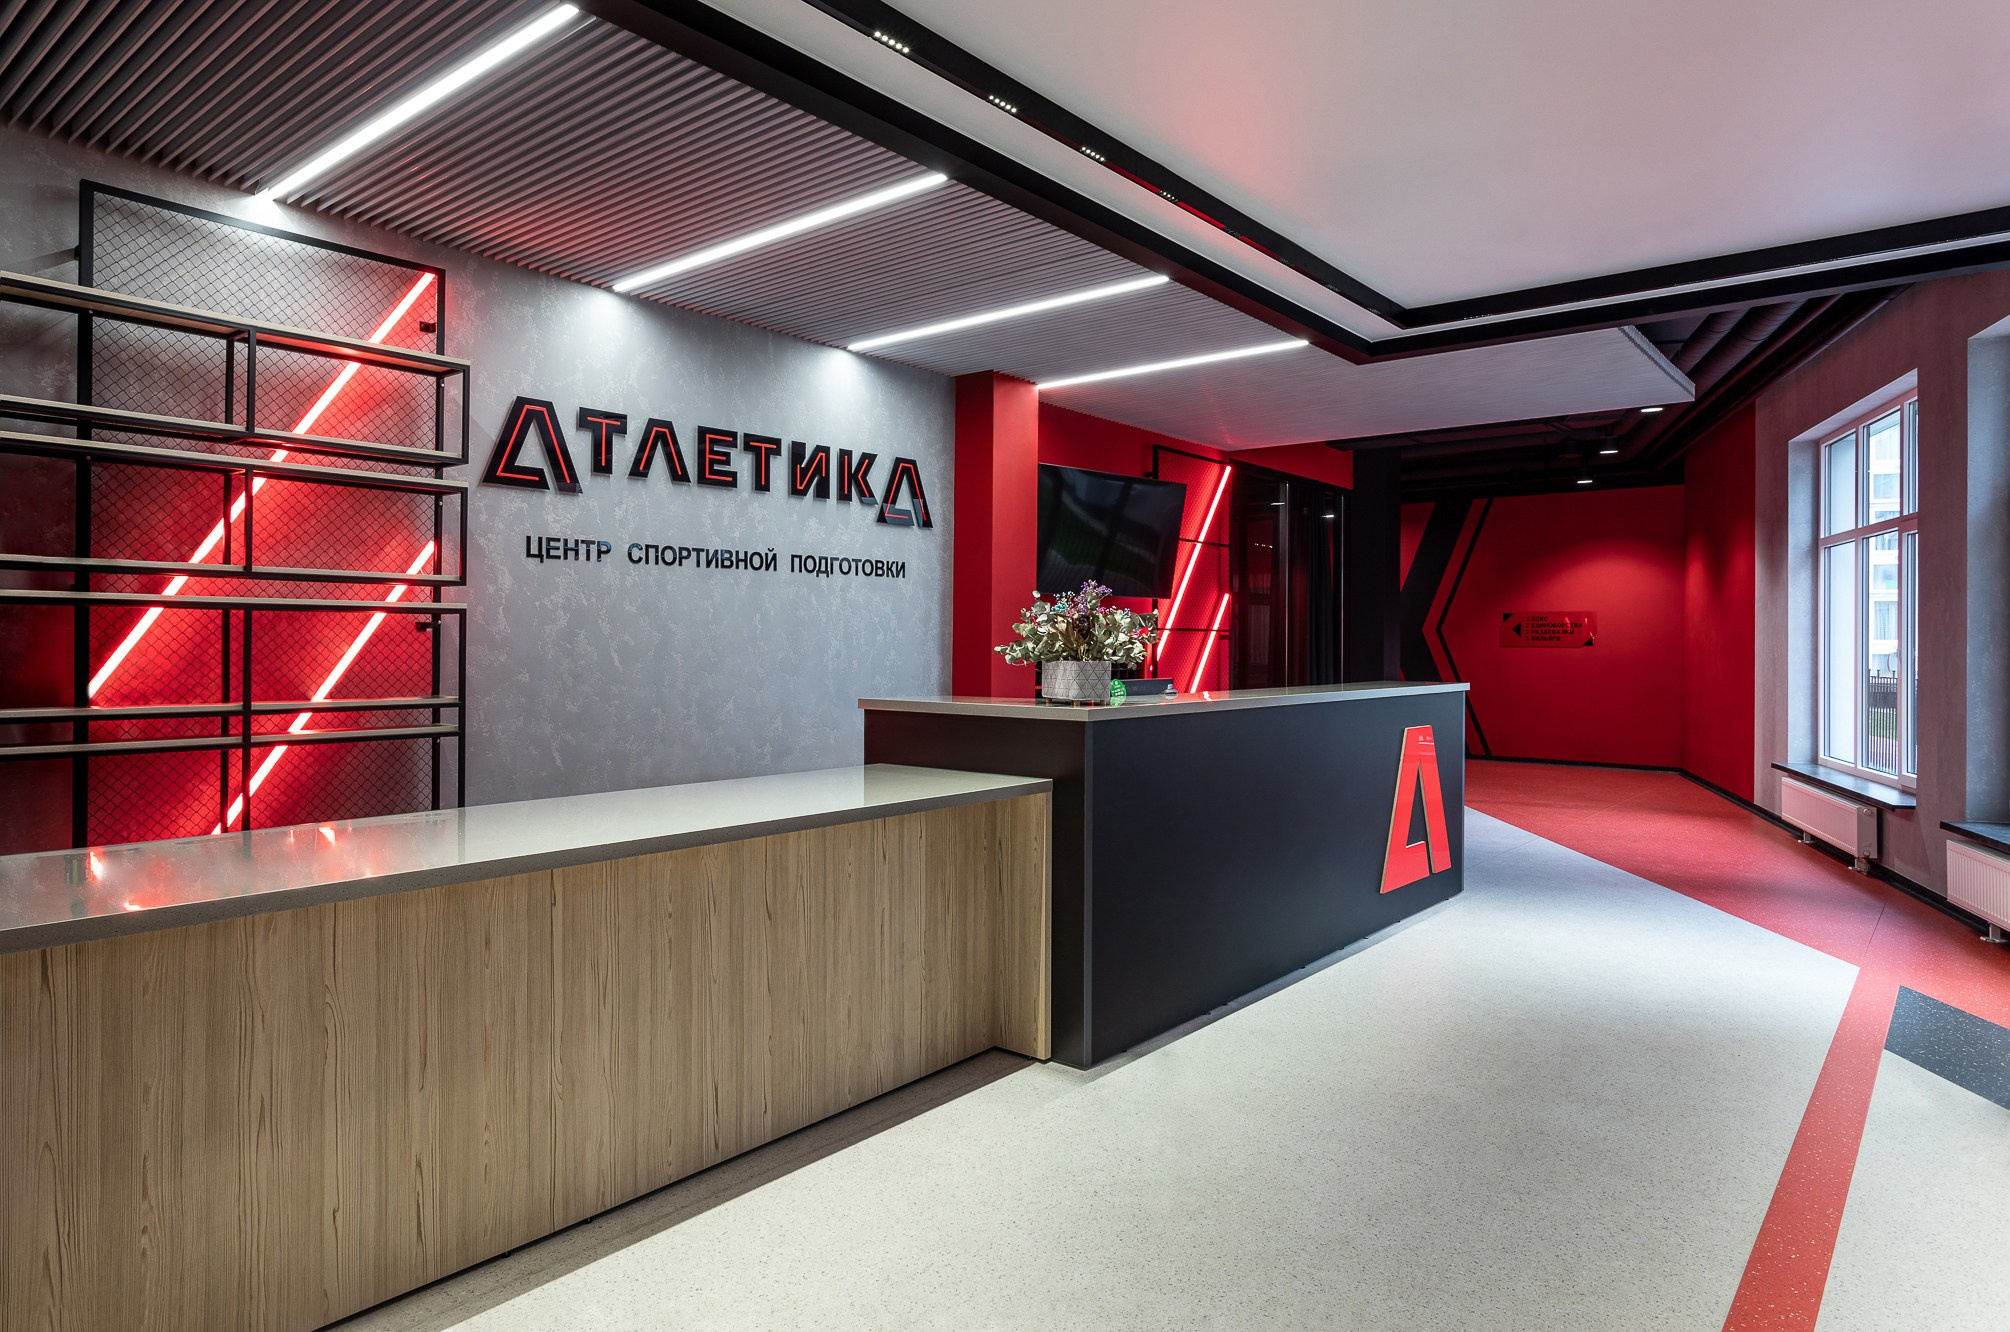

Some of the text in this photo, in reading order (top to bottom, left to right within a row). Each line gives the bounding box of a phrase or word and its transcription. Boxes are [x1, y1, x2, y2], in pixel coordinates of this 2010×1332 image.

[482, 396, 935, 529] АТЛЕТИКА
[525, 535, 906, 579] ЦЕНТР СПОРТИВНОЙ ПОДГОТОВКИ
